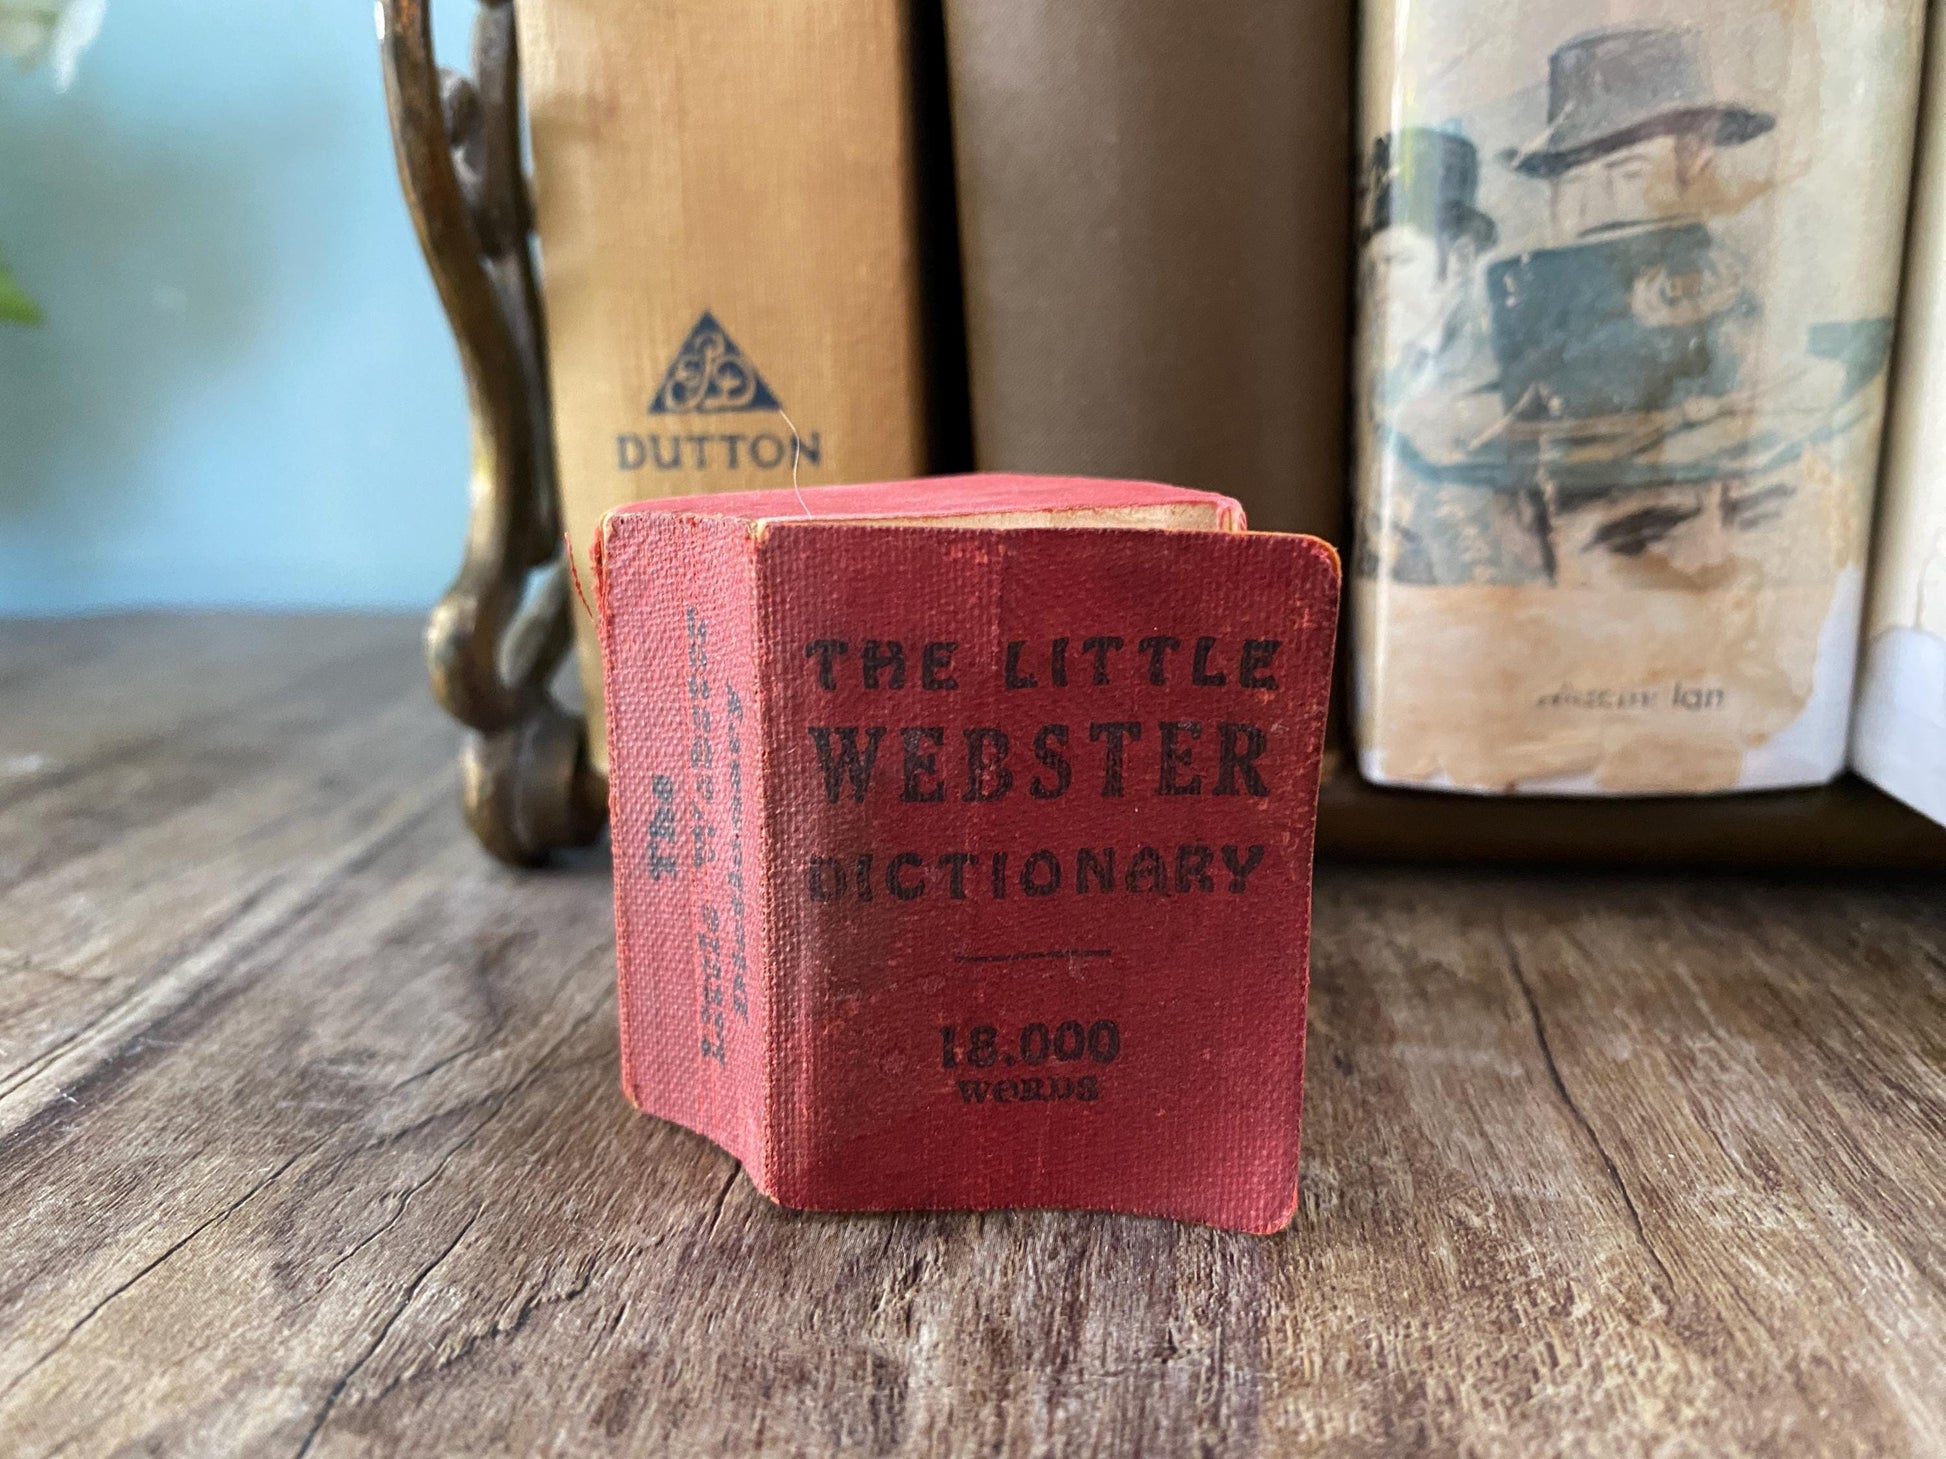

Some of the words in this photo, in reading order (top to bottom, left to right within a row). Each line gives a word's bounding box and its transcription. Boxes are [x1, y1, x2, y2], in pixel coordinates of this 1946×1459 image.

[616, 431, 821, 471] DUTTON
[804, 639, 958, 691] THE
[1003, 635, 1283, 692] LITTLE
[807, 720, 1271, 804] WEBSTER
[647, 773, 678, 882] The
[725, 680, 750, 1024] Dictionary
[808, 843, 1265, 902] DICTIONARY
